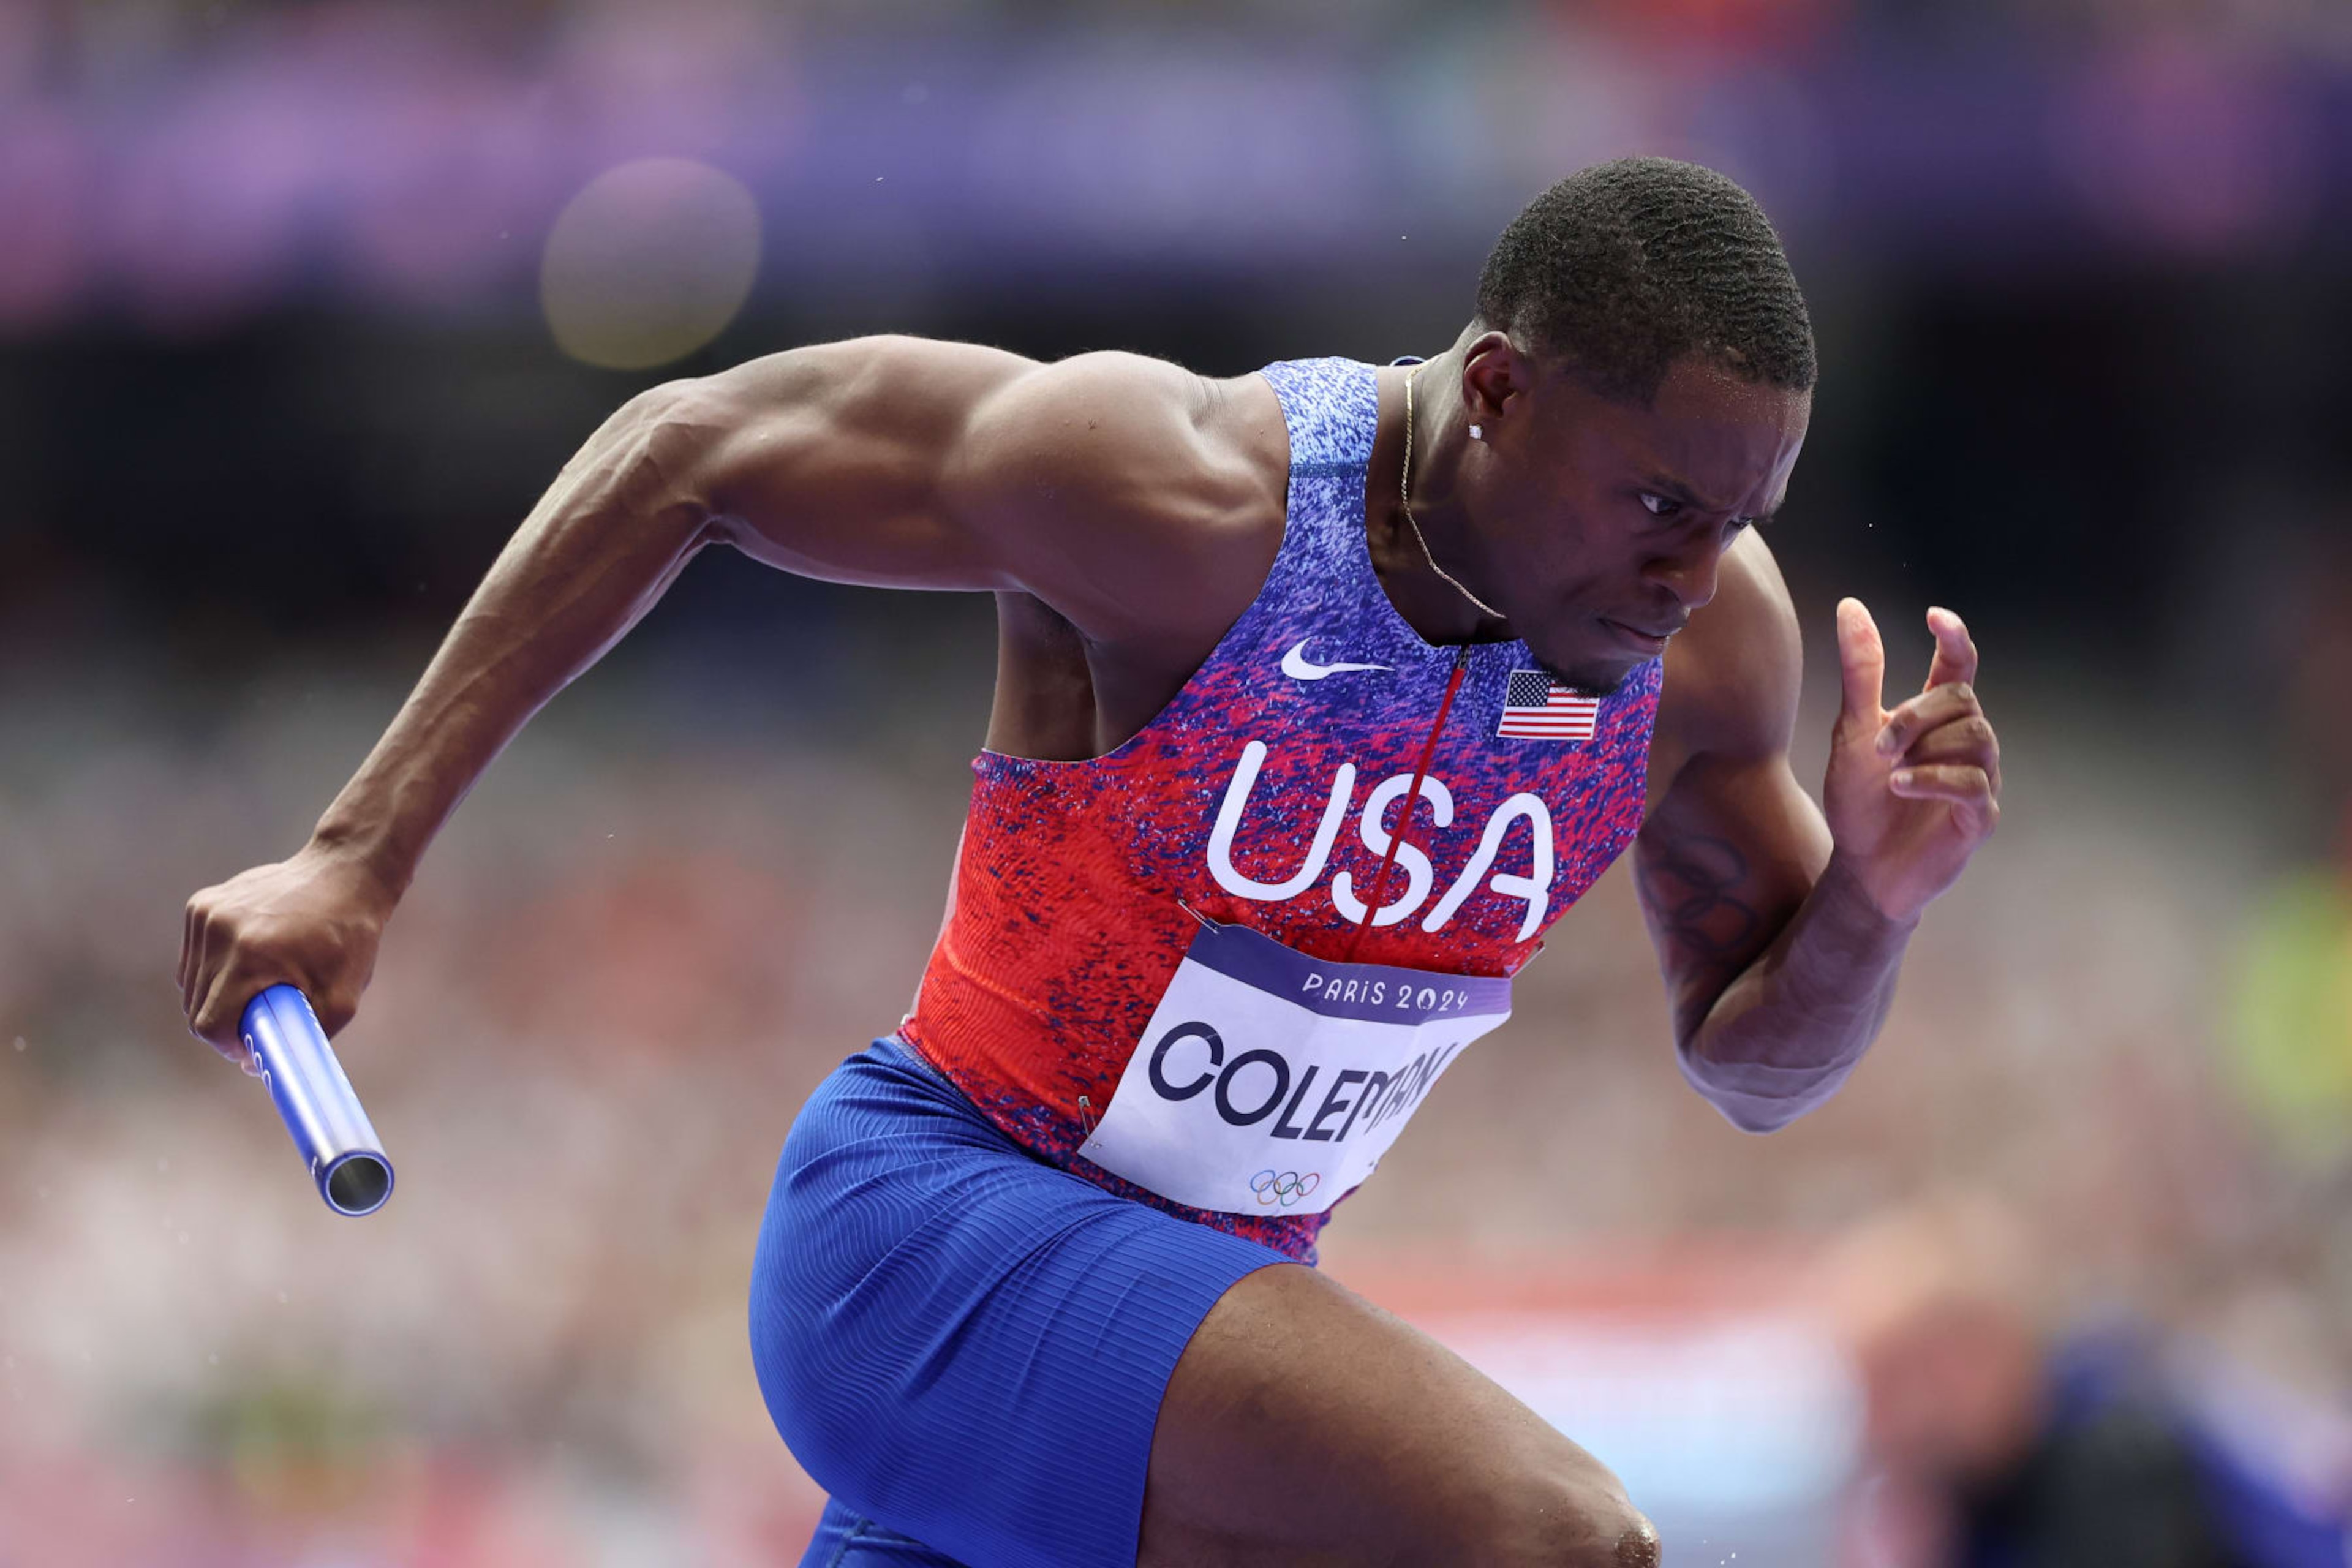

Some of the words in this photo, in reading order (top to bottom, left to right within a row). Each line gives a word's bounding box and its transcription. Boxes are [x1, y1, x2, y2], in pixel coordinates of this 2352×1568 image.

[1207, 740, 1554, 943] USA
[1396, 985, 1468, 1011] 2024
[1148, 1021, 1458, 1142] COLEMAN
